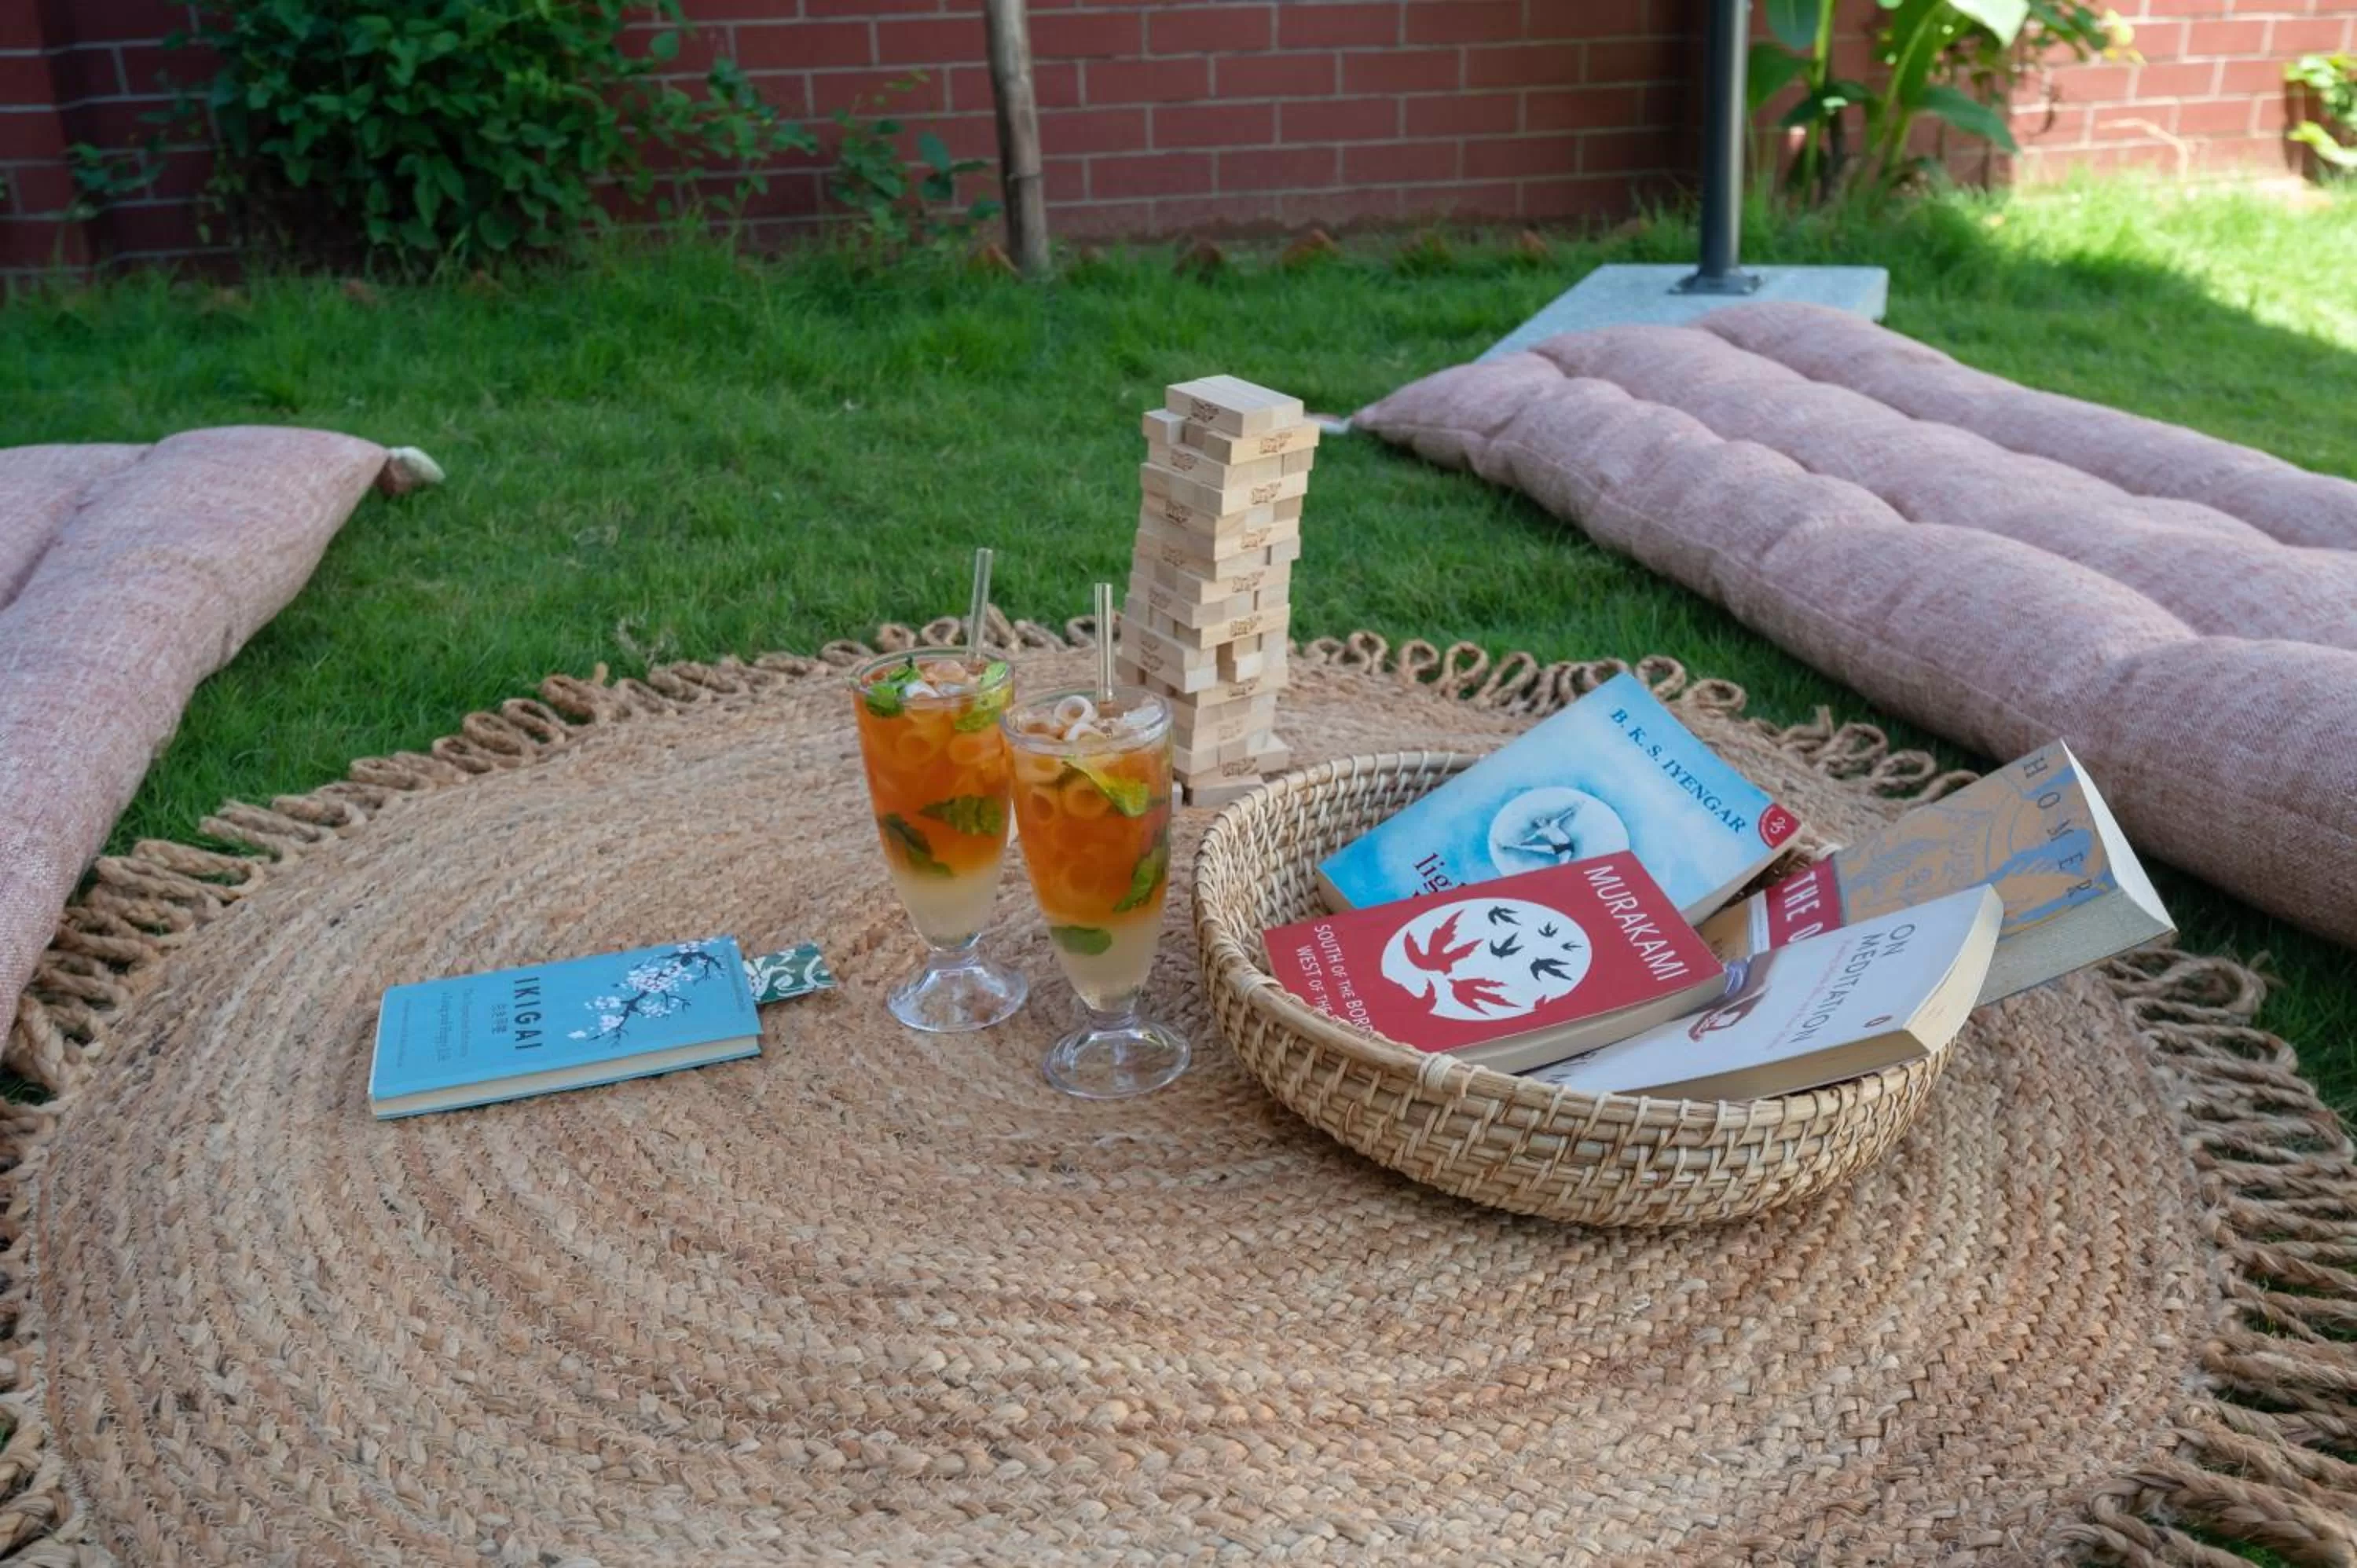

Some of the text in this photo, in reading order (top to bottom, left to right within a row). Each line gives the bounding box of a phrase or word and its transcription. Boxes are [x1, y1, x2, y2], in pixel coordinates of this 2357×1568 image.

[1610, 708, 1628, 728] B.
[1628, 726, 1647, 746] K.
[1648, 744, 1663, 762] S.
[1662, 759, 1747, 833] IYENGAR
[1414, 852, 1467, 893] lig
[1782, 870, 1821, 922] THE
[1583, 865, 1690, 981] MURAKAMI
[1879, 923, 1916, 958] ON
[1296, 944, 1323, 976] WEST
[1314, 924, 1346, 964] SOUTH
[1308, 980, 1324, 992] OF
[1331, 965, 1348, 979] OF
[1338, 980, 1356, 999] THE
[1787, 932, 1887, 1044] MEDITATION
[513, 976, 543, 1050] IKIGAI
